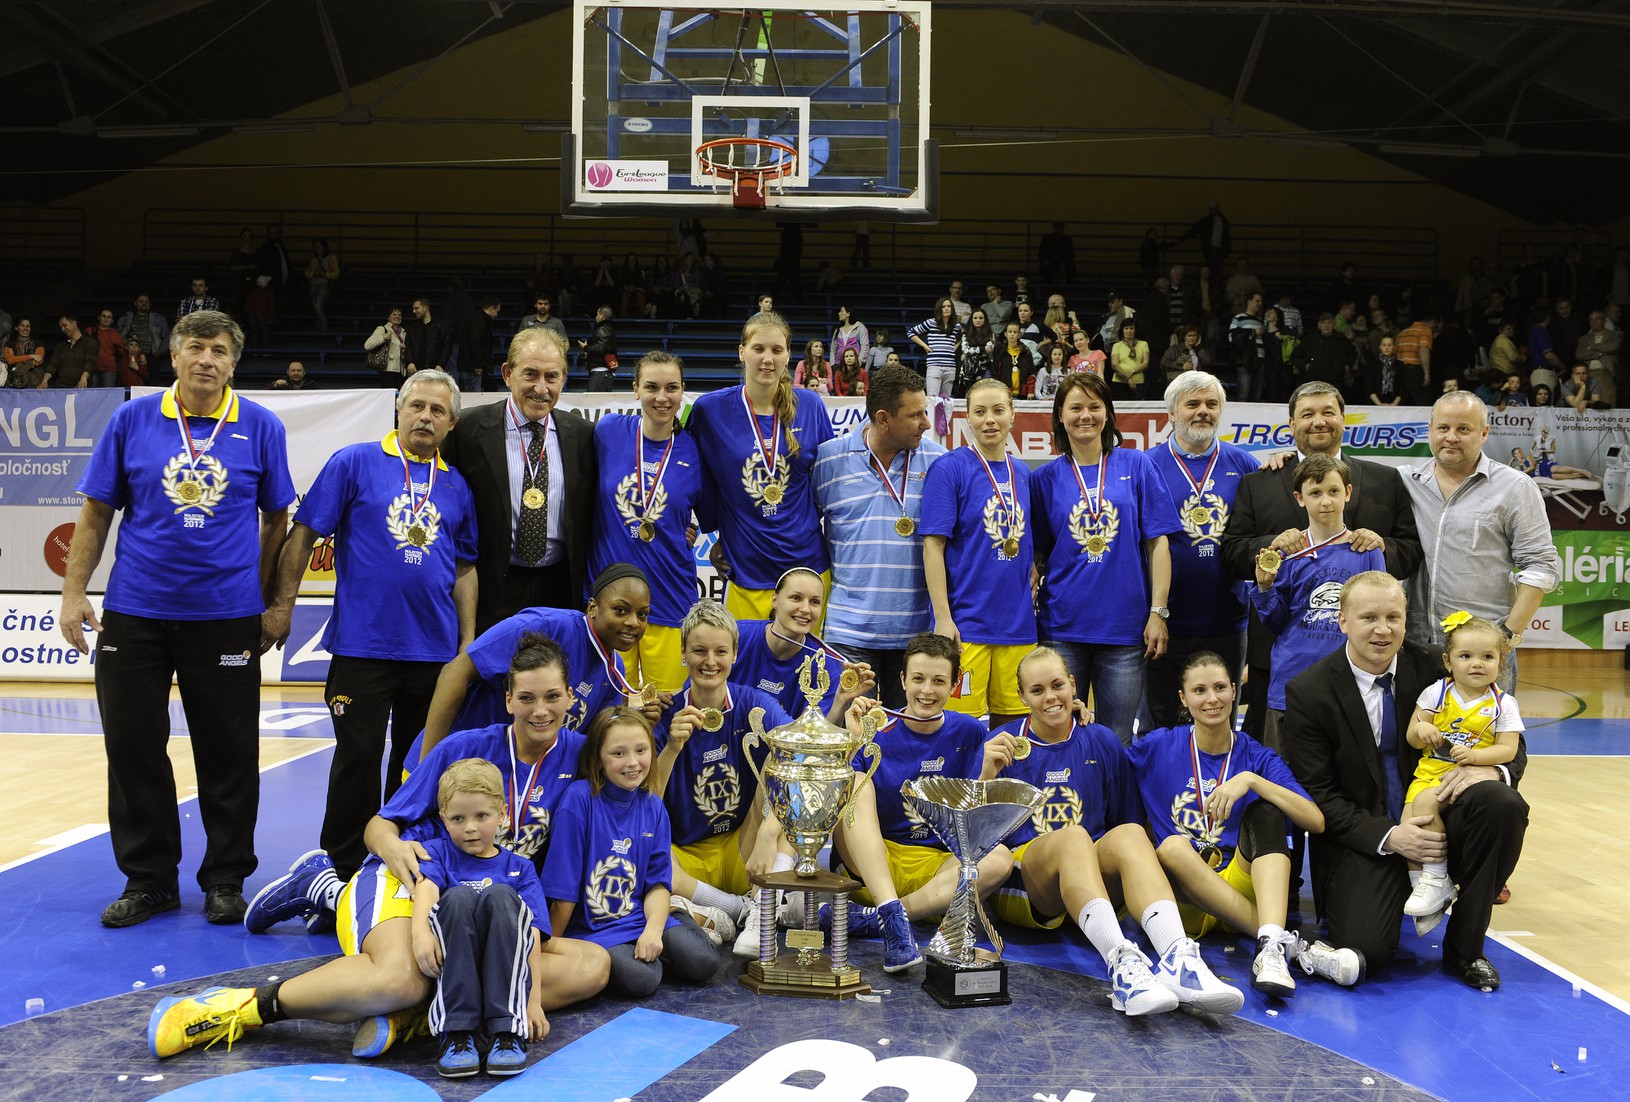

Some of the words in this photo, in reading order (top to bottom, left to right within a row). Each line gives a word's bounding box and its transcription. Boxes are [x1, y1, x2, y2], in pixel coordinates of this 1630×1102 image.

[1488, 412, 1535, 430] ictory
[184, 520, 204, 528] 2012
[404, 556, 422, 565] 2012
[707, 778, 730, 799] IX
[1045, 803, 1071, 822] IX
[602, 874, 630, 898] IX
